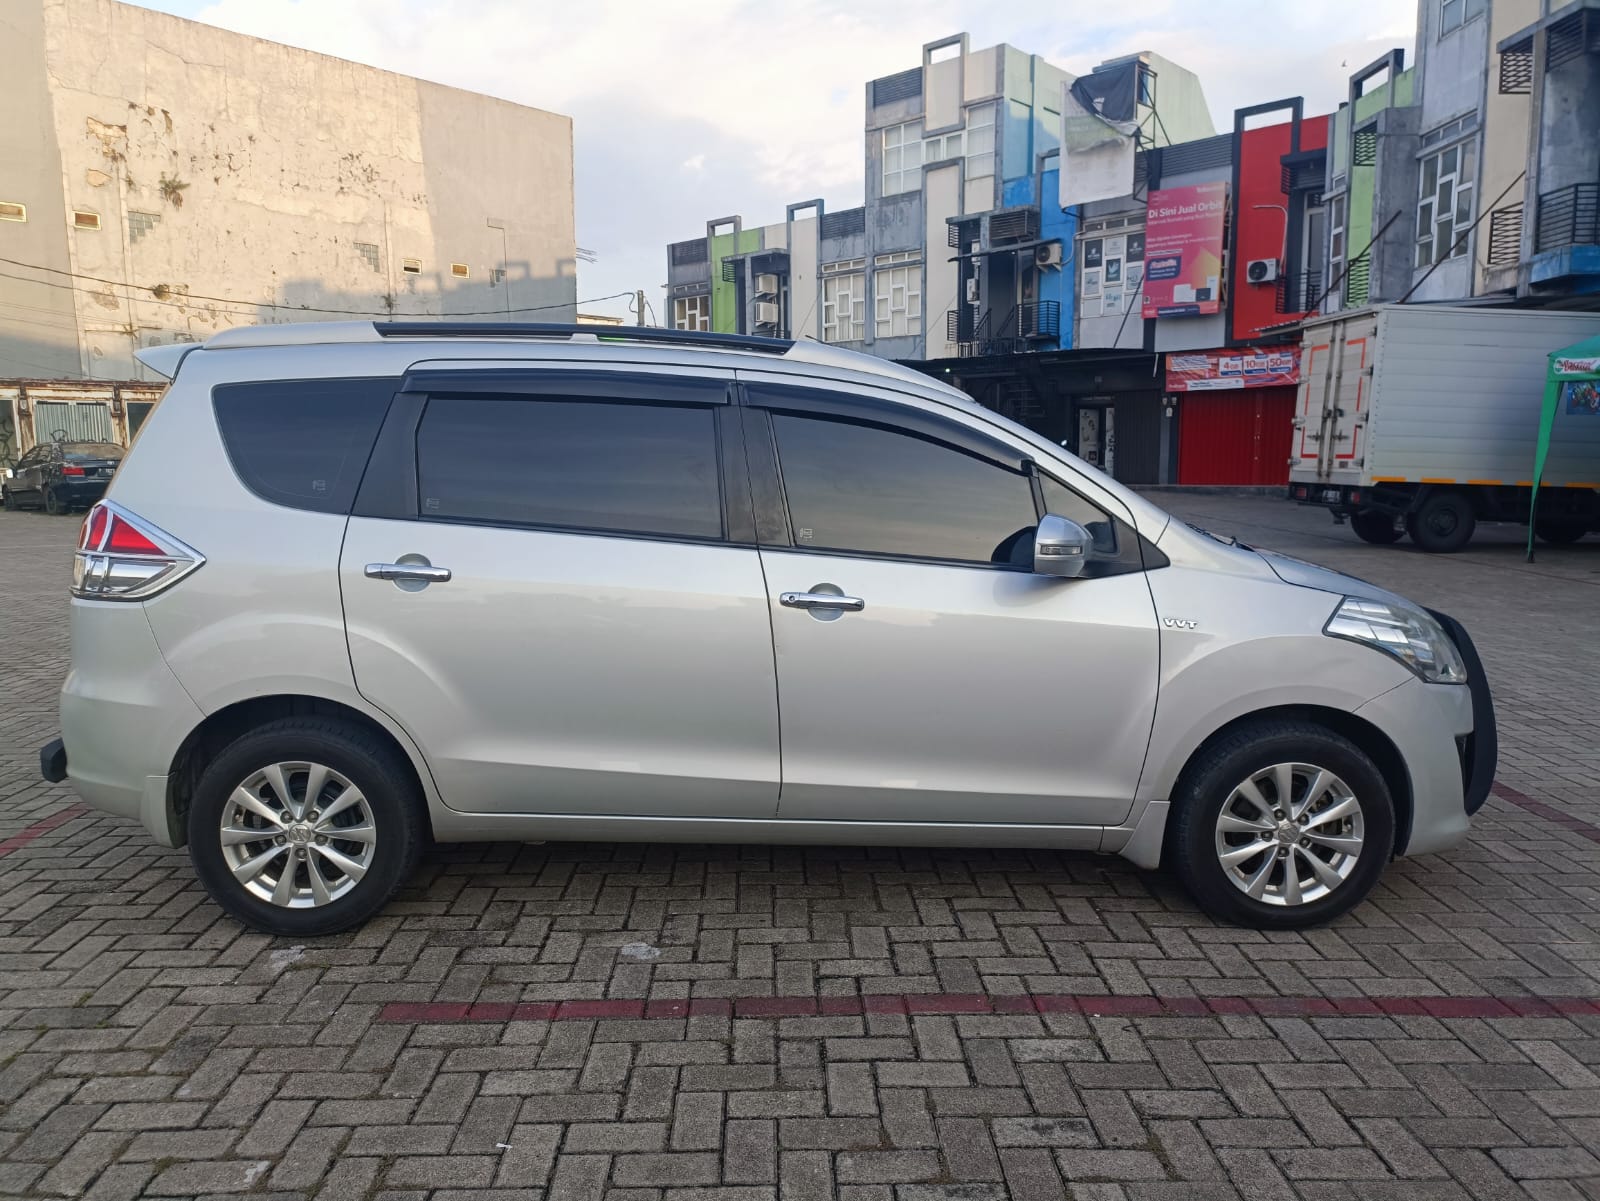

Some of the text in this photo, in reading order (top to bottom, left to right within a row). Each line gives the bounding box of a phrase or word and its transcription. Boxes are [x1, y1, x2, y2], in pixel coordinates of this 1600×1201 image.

[1148, 200, 1223, 218] Di Sini Jual Orbit
[1163, 618, 1198, 629] VVT
